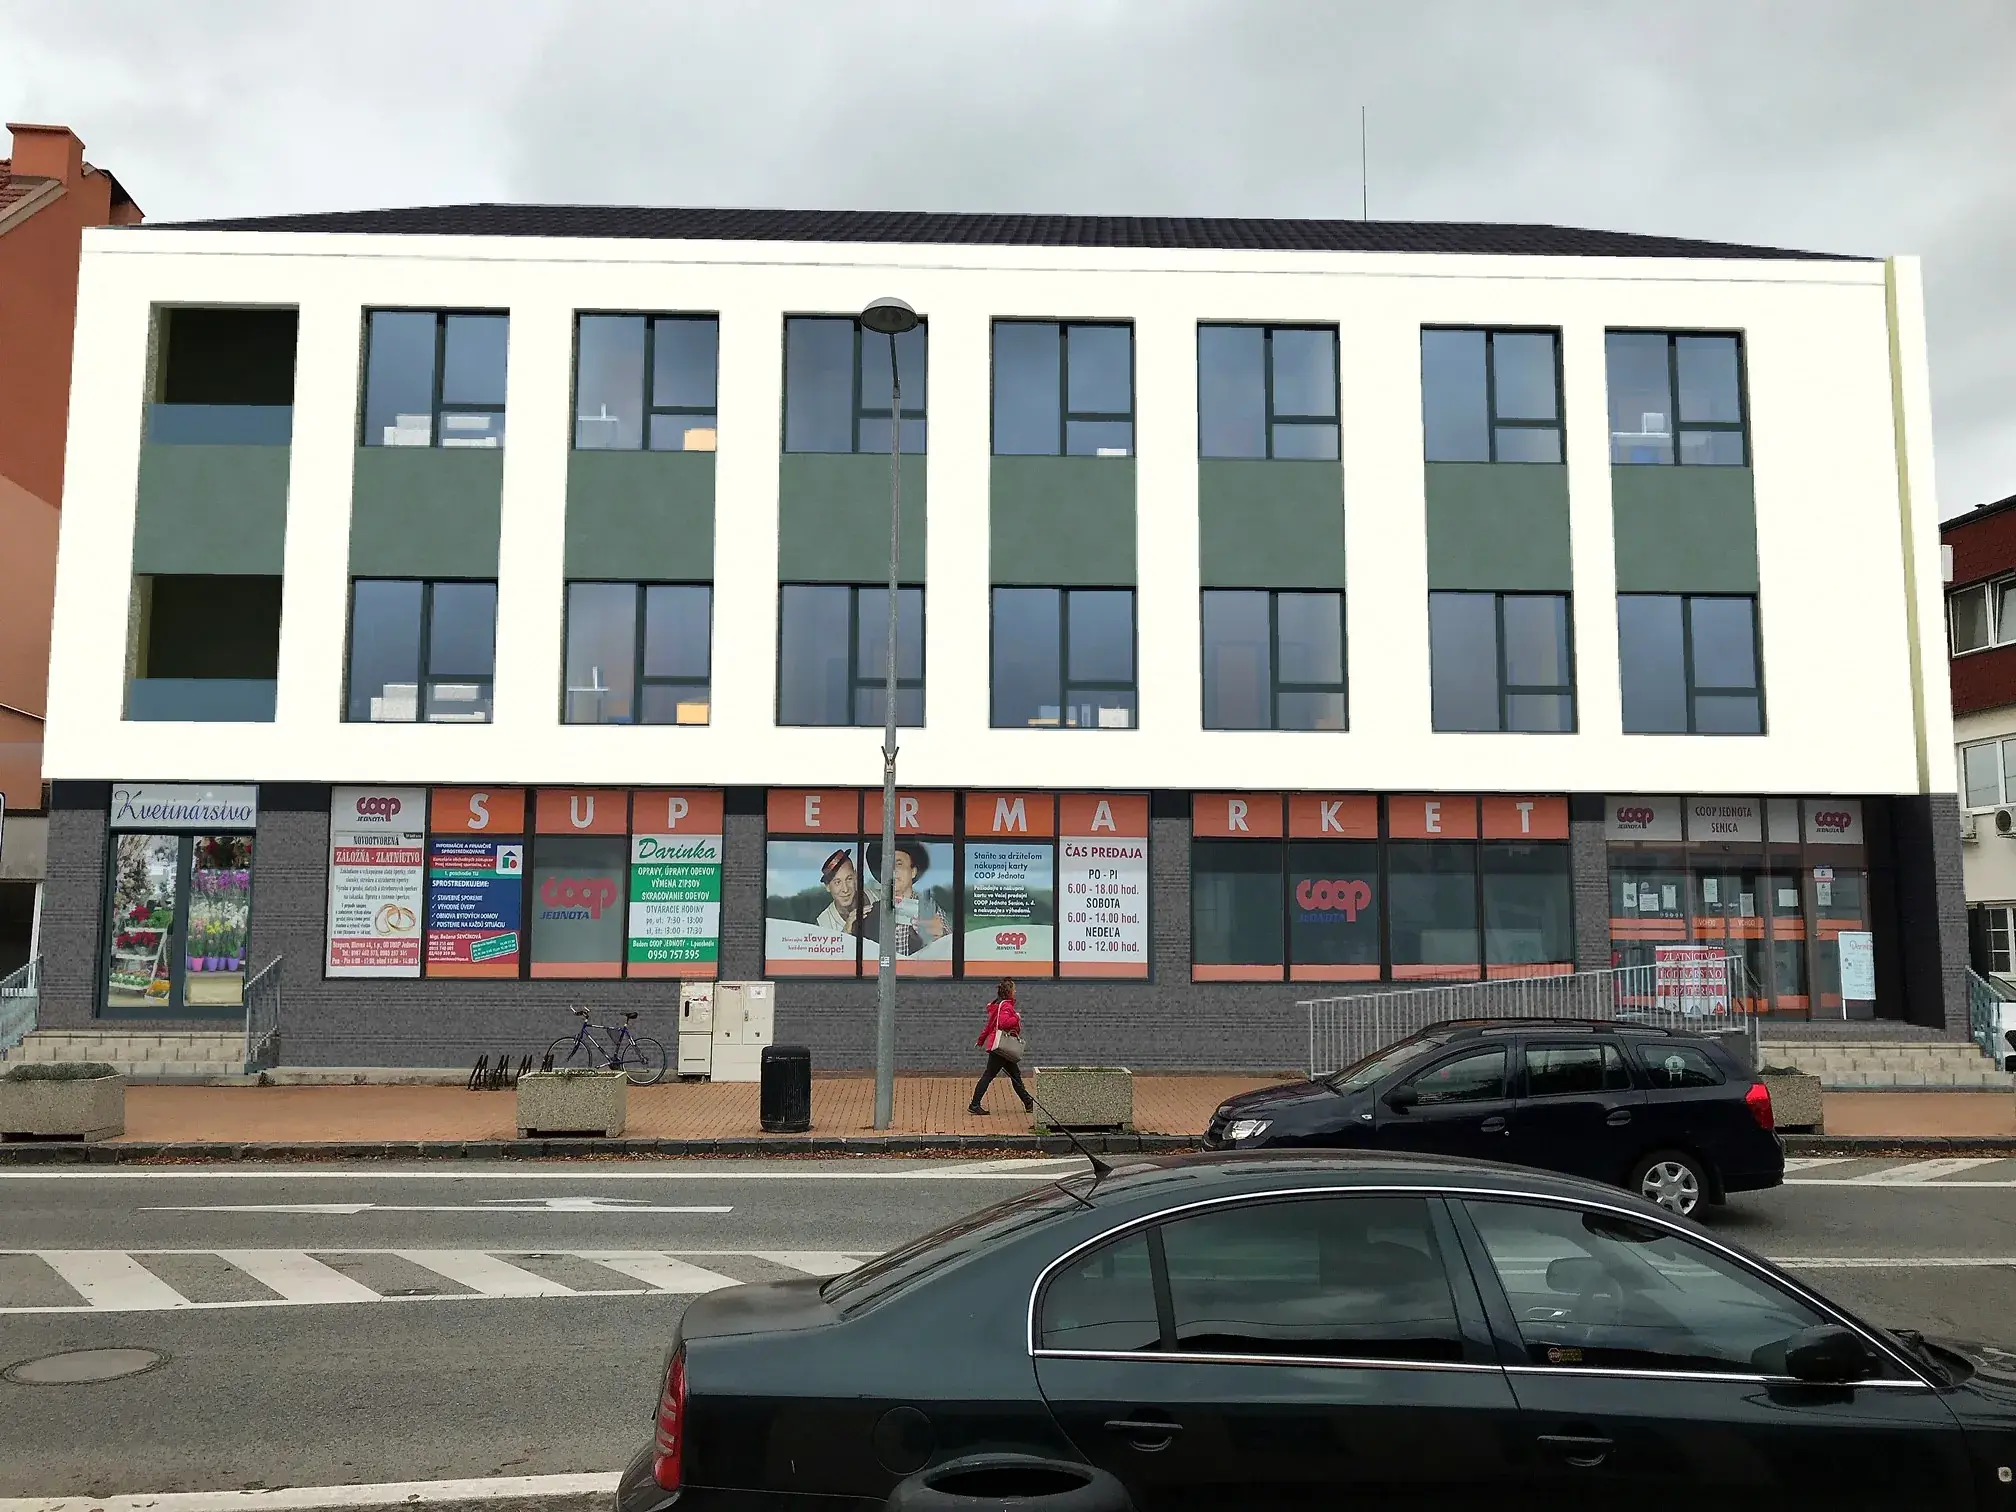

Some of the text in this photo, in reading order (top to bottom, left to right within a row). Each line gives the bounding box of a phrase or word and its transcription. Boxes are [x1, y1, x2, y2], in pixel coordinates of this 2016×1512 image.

[114, 790, 253, 821] Kvetinárstvo
[467, 792, 1534, 833] S U P E R M A R K E T
[1695, 806, 1752, 817] COOP JEDNOTA
[1711, 822, 1739, 833] SENICA
[638, 837, 718, 860] Darinka
[1065, 843, 1143, 858] ČAS PREDAJA
[973, 851, 997, 860] Staňte
[637, 865, 715, 877] OPRAVY, ÚPRAVY ODEVOV
[974, 862, 1029, 872] nákupnej karty
[974, 871, 1025, 880] COOP Jednota
[1088, 869, 1101, 880] PO
[1109, 869, 1118, 880] PI
[651, 878, 701, 888] VÝMENA ZIPSOV
[1067, 883, 1087, 894] 6.00
[1095, 884, 1119, 895] 18.00
[1121, 884, 1140, 895] hod.
[541, 876, 618, 919] coop
[641, 891, 710, 900] SKRACOVANIE ODEVOV
[1295, 878, 1372, 922] coop
[1086, 898, 1121, 909] SOBOTA
[681, 905, 705, 914] HODINY
[539, 911, 590, 920] JEDNOTA
[1067, 912, 1087, 923] 6.00
[1095, 912, 1119, 923] 14.00
[1121, 913, 1140, 924] hod.
[1085, 926, 1121, 938] NEDEĽA
[803, 933, 830, 945] zľavy
[830, 934, 843, 944] pri
[808, 944, 845, 955] nákupe!
[1067, 940, 1087, 952] 8.00
[1095, 940, 1119, 952] 12.00
[1121, 941, 1140, 952] hod.
[647, 949, 700, 960] 0950 757 395
[1663, 951, 1717, 961] ZLATNÍCTVO
